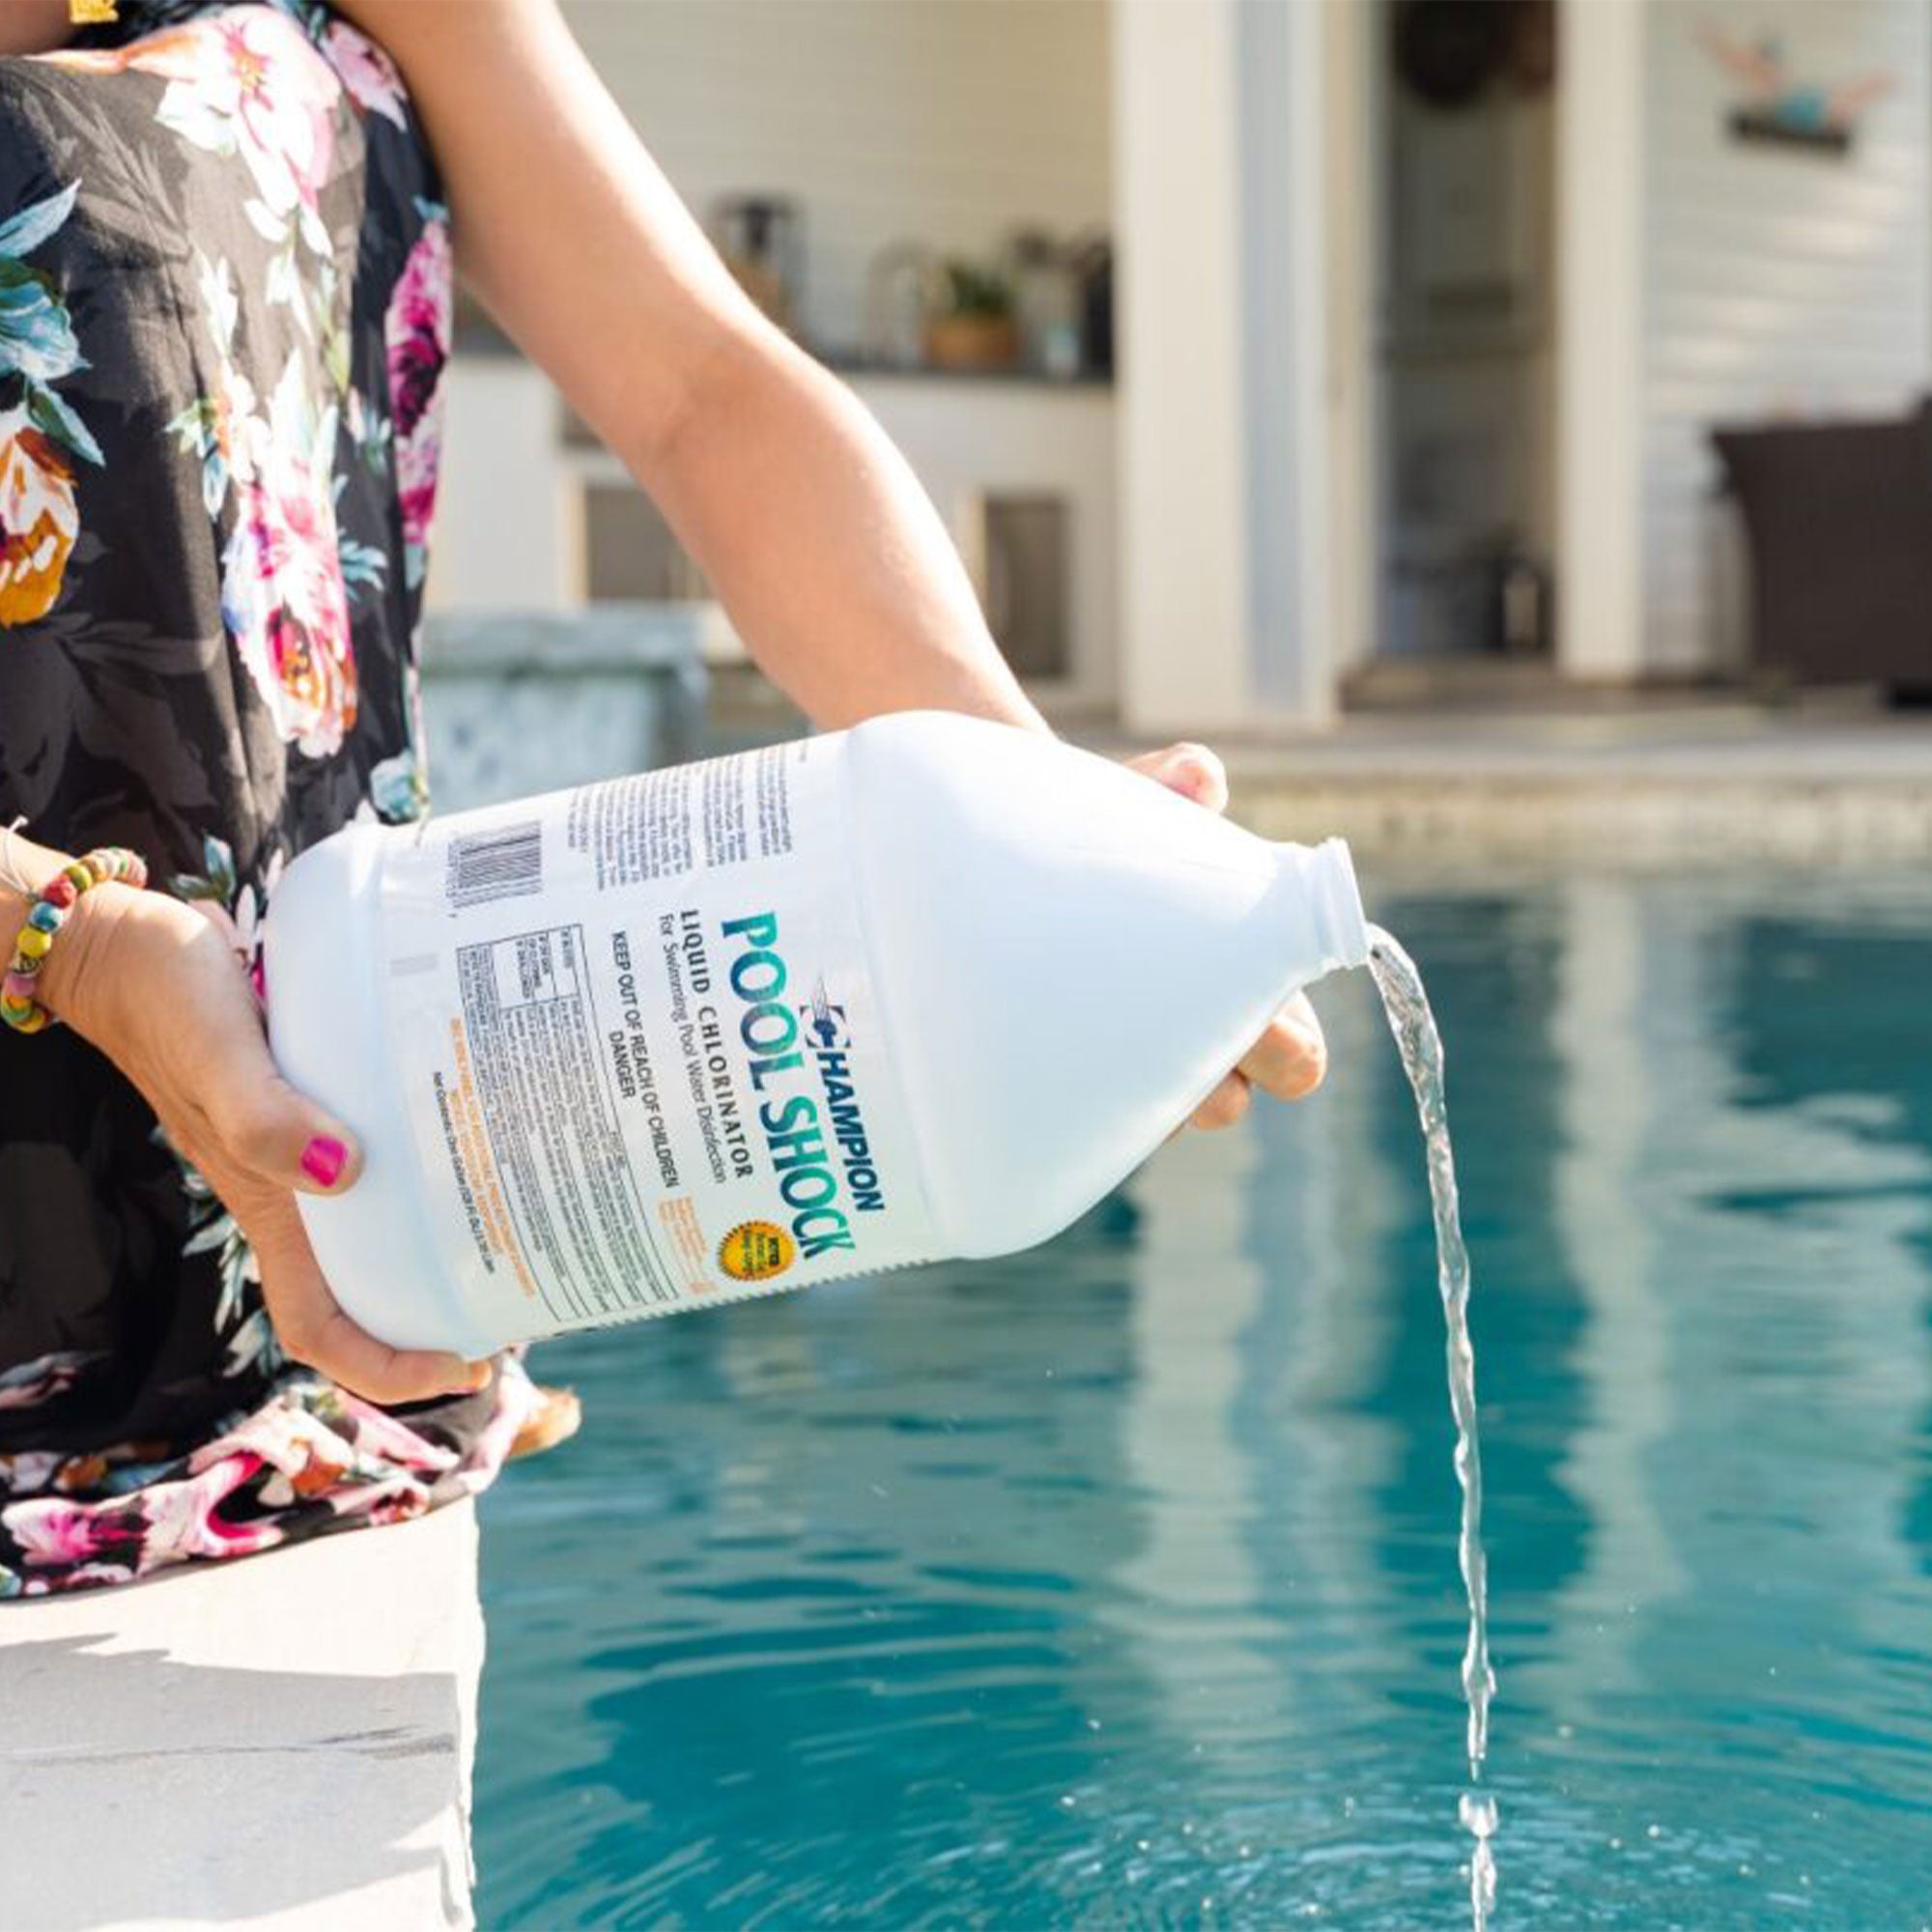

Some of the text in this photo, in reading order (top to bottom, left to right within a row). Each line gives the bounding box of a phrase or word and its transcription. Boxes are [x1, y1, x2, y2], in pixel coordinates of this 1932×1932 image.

[610, 1031, 636, 1097] DANGER
[612, 931, 679, 1188] KEEP OUT OF REACH OF CHILDREN
[660, 914, 726, 1183] For Swimming Pool Water Disinfection
[681, 910, 753, 1178] LIQUID CHLORINATOR
[722, 913, 804, 1091] POOL
[759, 1096, 855, 1260] SHOCK
